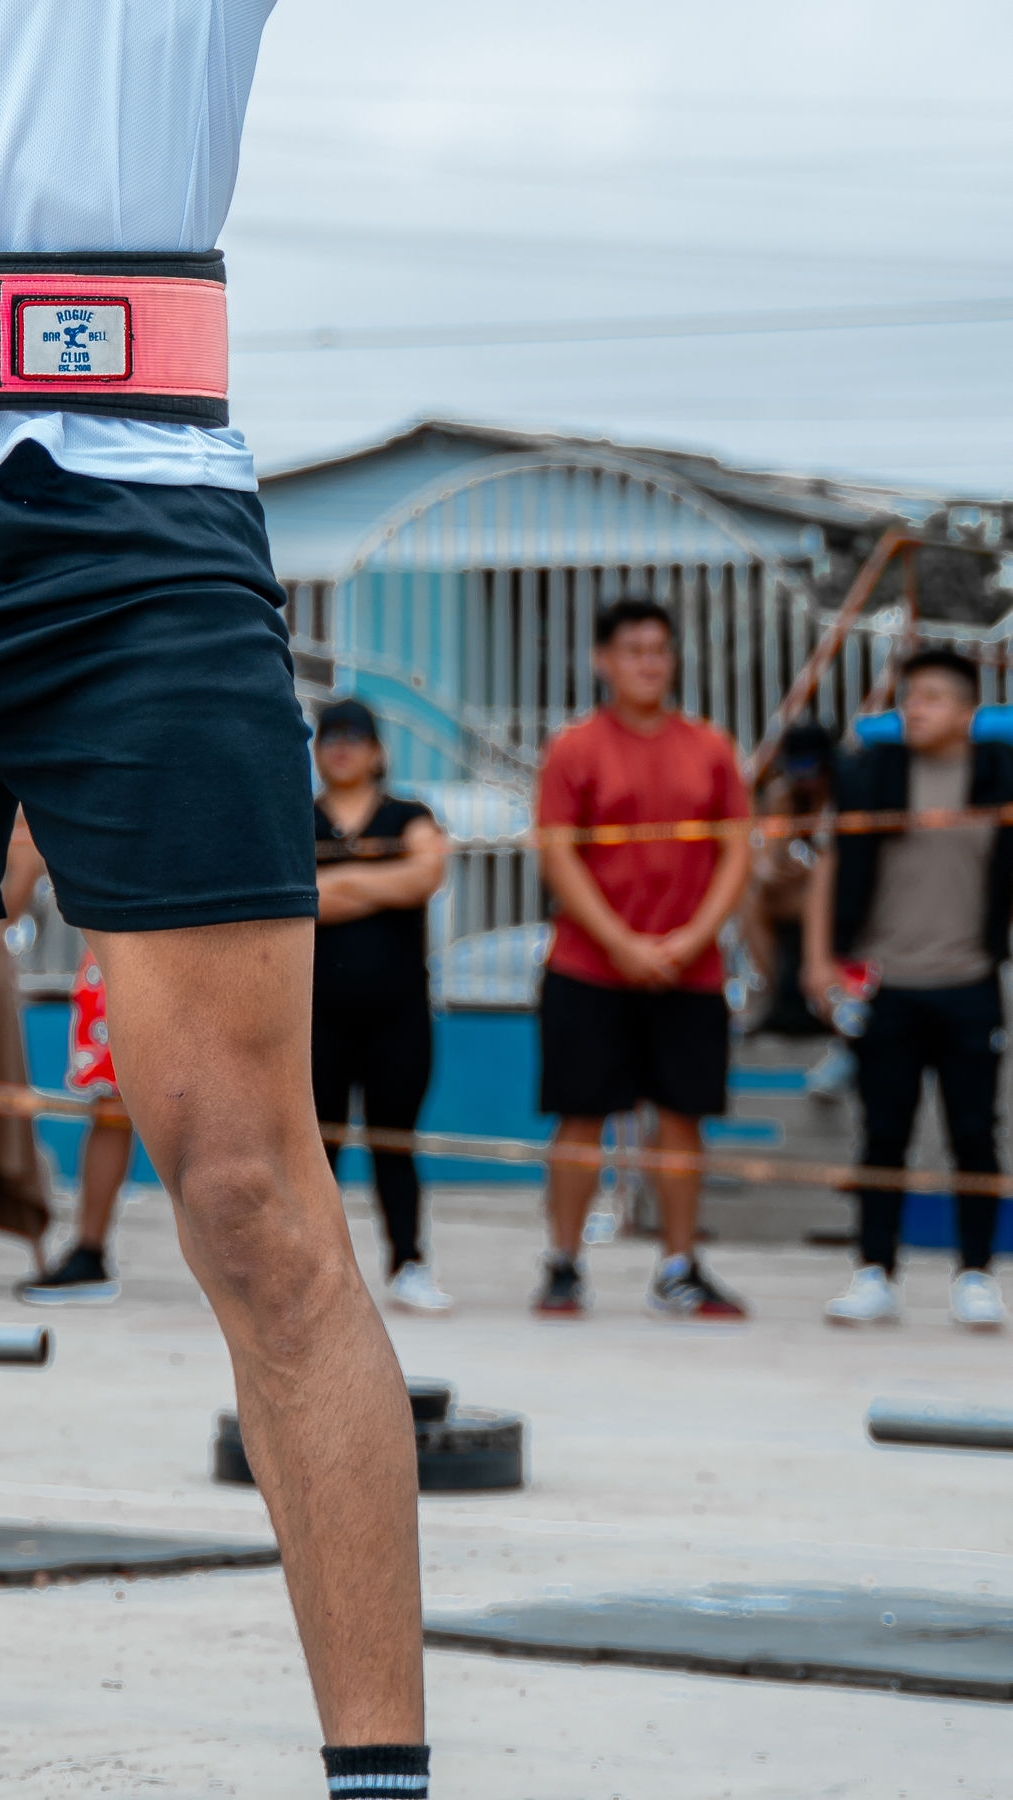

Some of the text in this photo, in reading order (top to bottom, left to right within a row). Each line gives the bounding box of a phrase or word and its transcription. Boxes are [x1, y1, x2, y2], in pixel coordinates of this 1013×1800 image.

[56, 309, 94, 324] ROGUE
[43, 331, 108, 342] BAR BELL
[61, 351, 90, 363] CLUB
